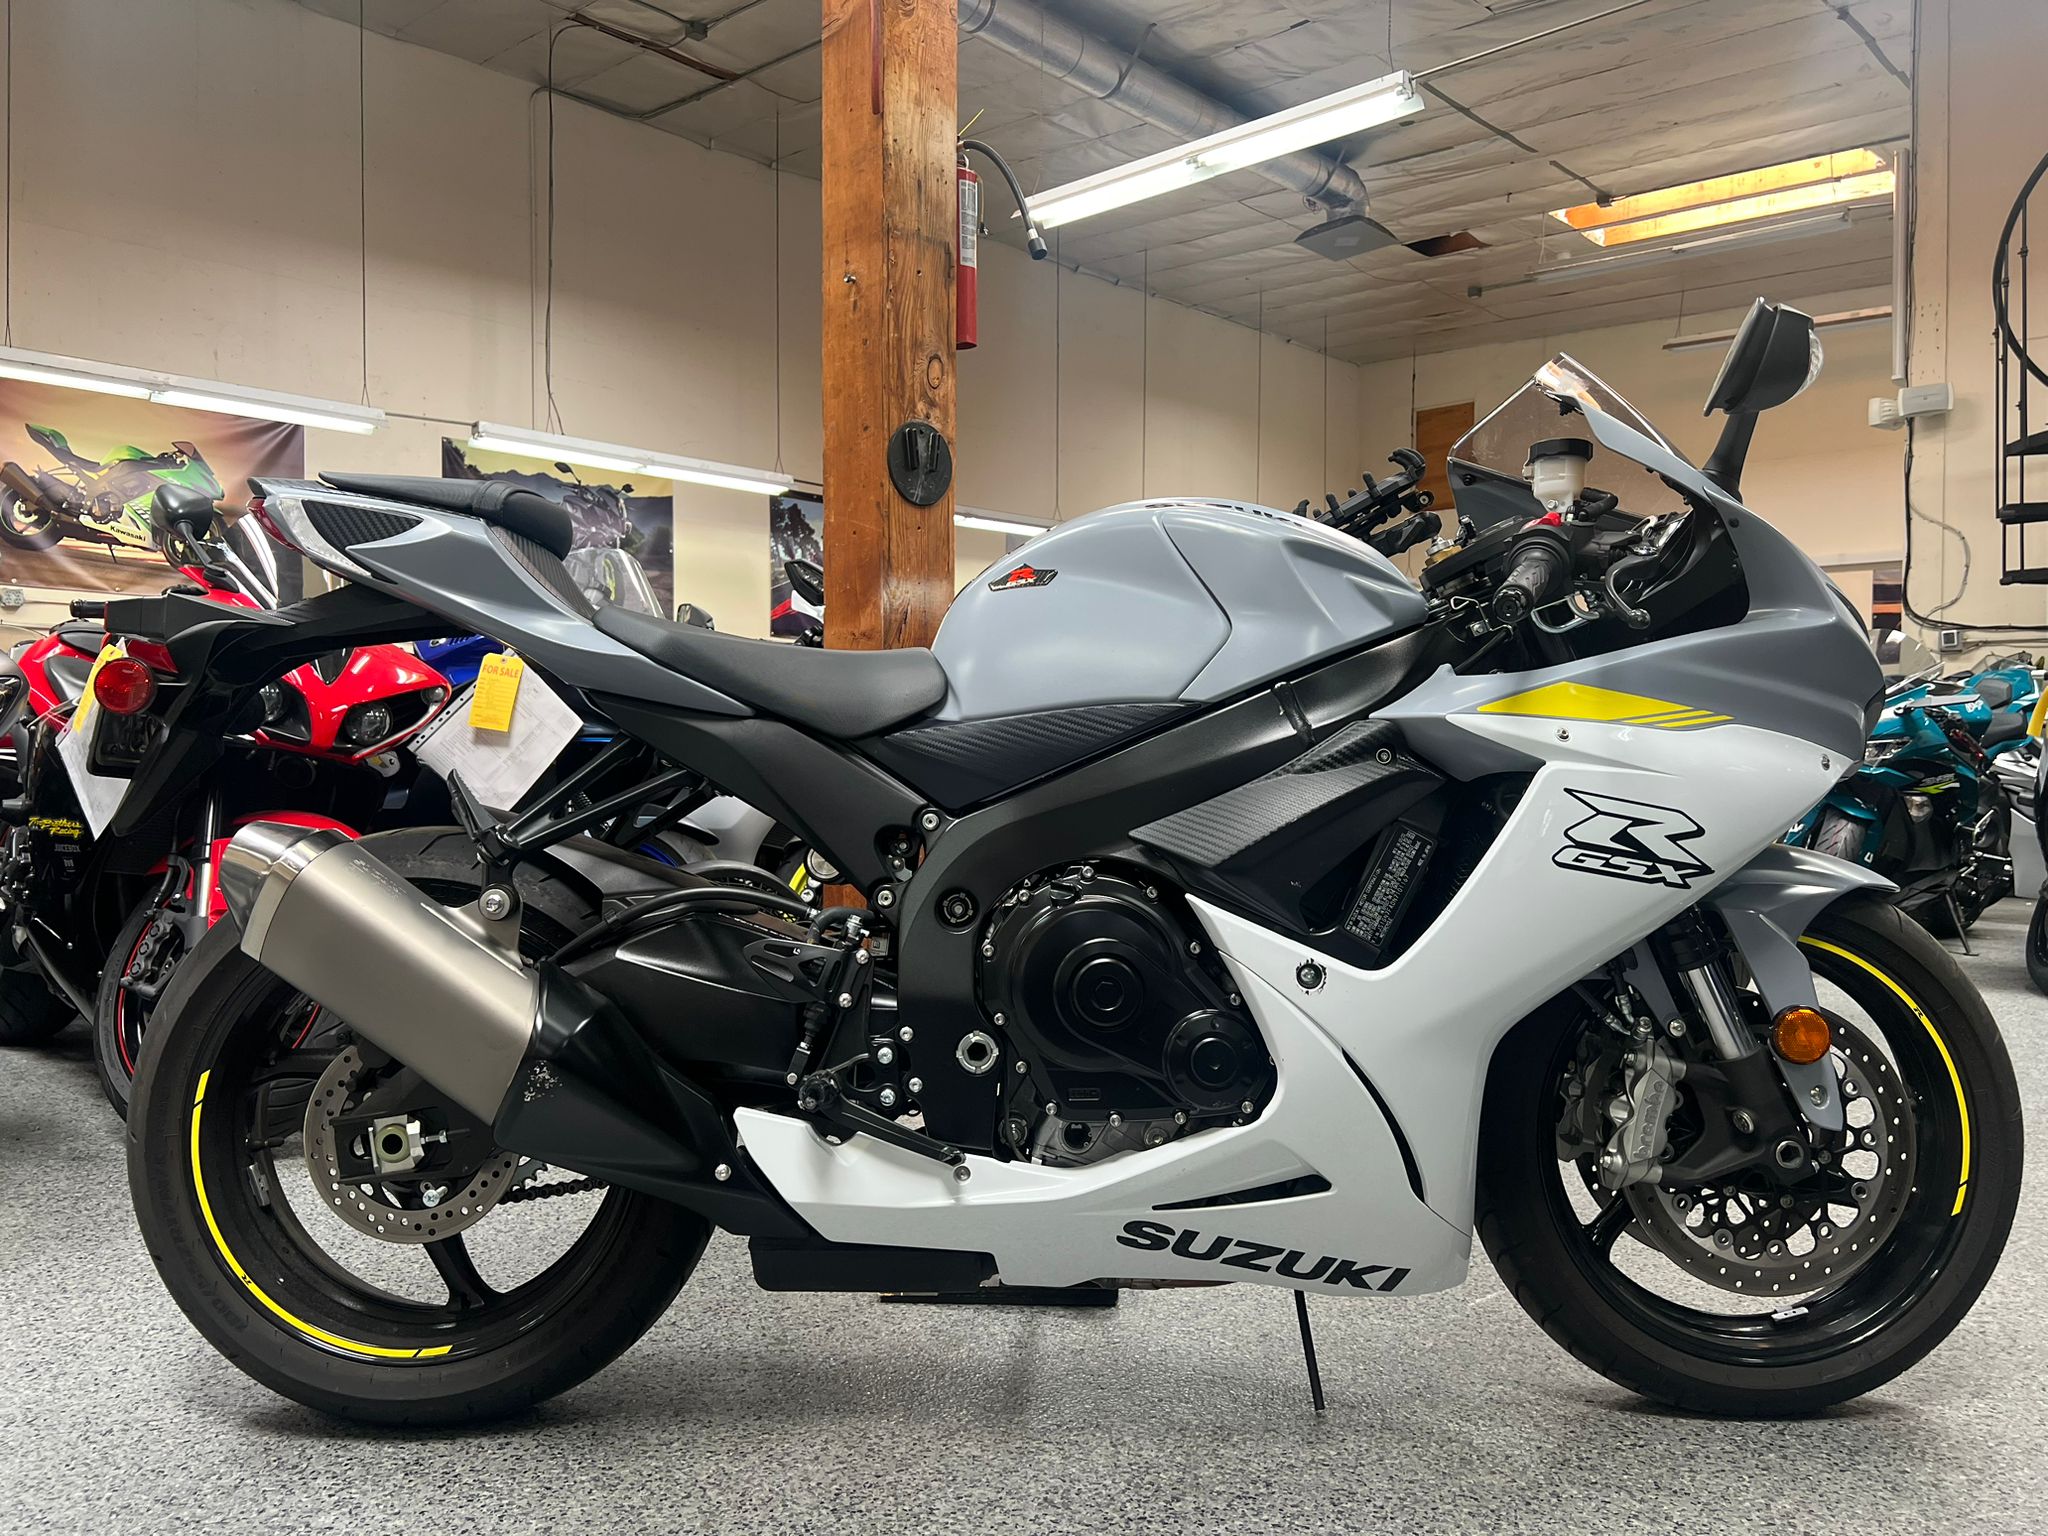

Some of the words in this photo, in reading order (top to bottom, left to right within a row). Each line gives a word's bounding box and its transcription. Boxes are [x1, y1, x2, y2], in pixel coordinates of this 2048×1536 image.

[110, 525, 146, 542] Kawasaki
[482, 664, 499, 675] FOR
[500, 666, 519, 678] SALE
[1552, 846, 1714, 890] GSX
[1632, 1080, 1667, 1159] brembo
[1115, 1219, 1412, 1293] SUZUKI
